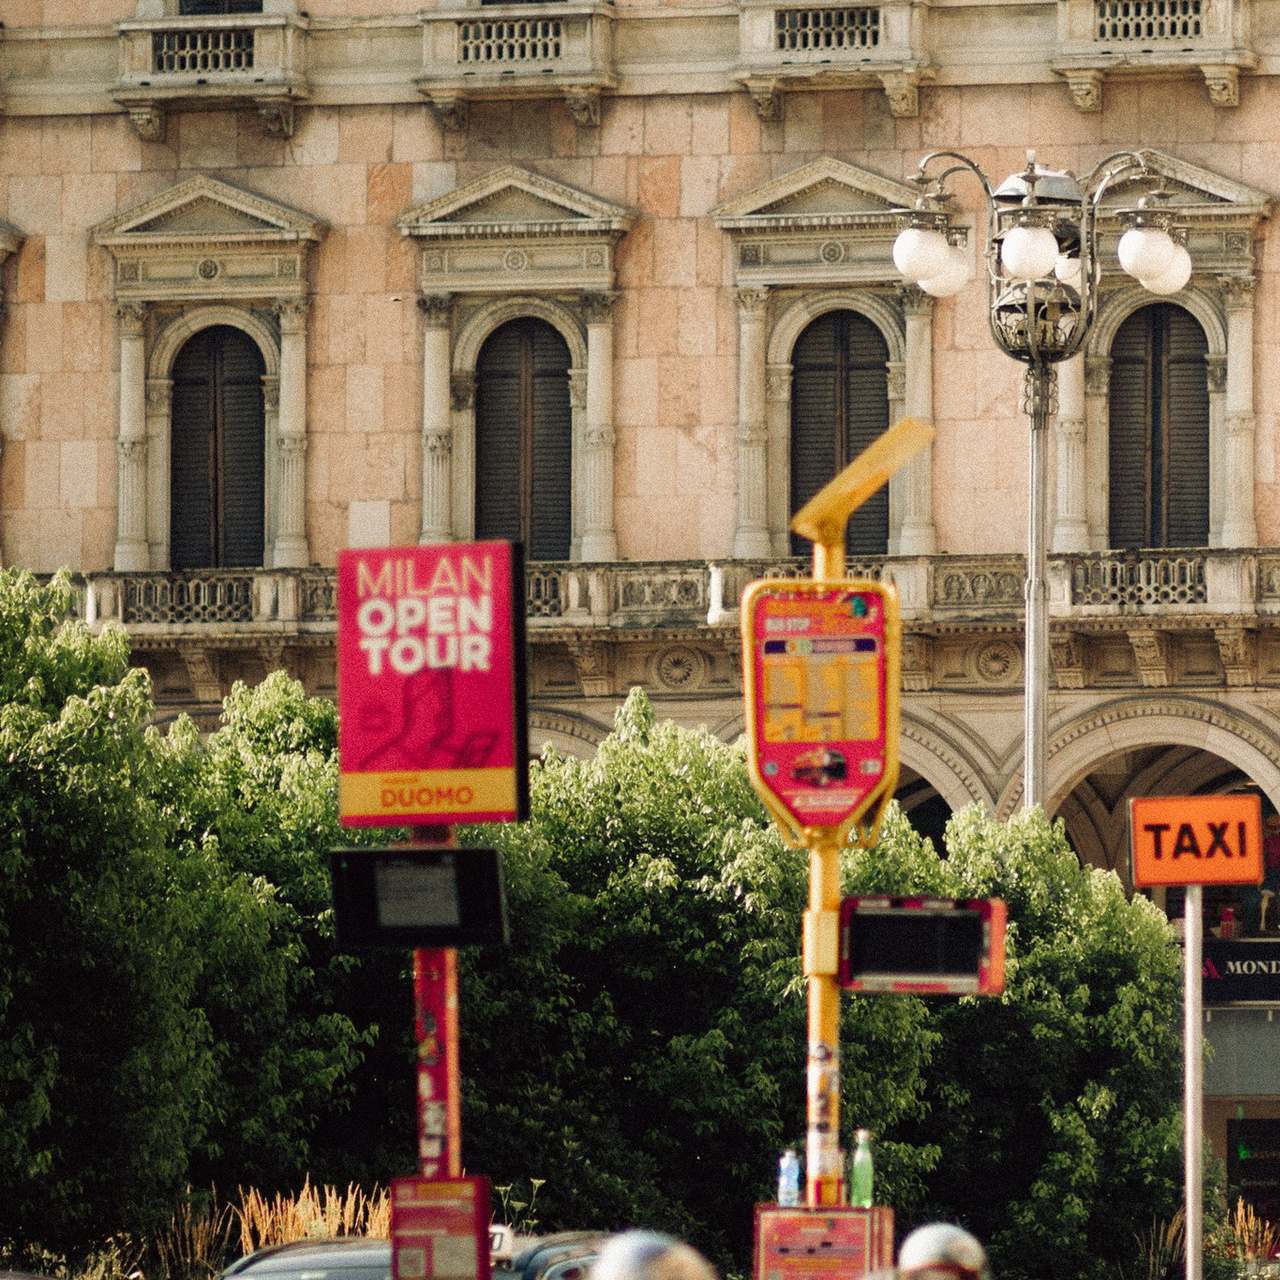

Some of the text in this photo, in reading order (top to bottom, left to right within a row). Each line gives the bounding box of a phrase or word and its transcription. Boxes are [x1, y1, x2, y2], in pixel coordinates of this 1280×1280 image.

[357, 554, 491, 599] MILAN
[358, 595, 492, 637] OPEN
[359, 634, 492, 676] TOUR
[380, 785, 474, 808] DUOMO
[1143, 821, 1248, 860] TAXI
